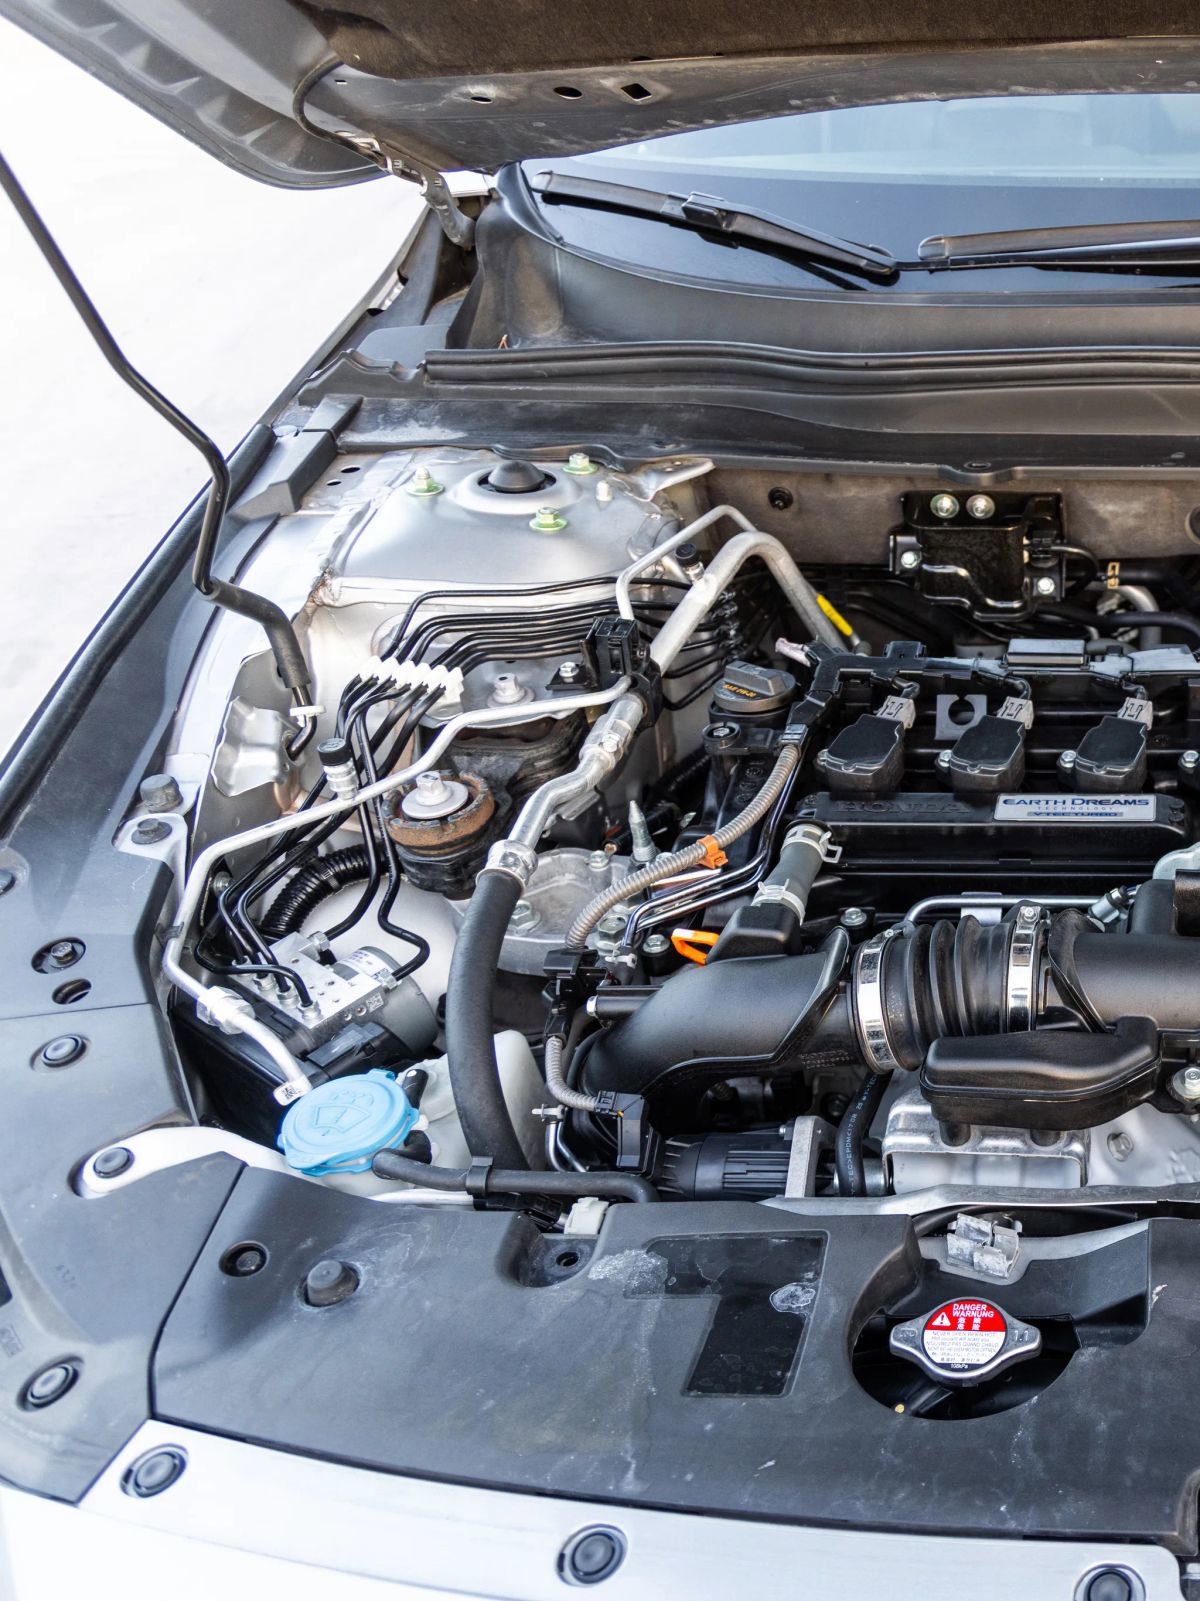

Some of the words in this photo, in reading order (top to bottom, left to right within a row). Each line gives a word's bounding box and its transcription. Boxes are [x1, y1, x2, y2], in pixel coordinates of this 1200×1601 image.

[1002, 798, 1066, 806] EARTH
[1071, 798, 1150, 806] DREAMS
[832, 800, 972, 813] HONDA
[953, 1303, 988, 1311] DANGER
[952, 1310, 995, 1318] WARNUNG
